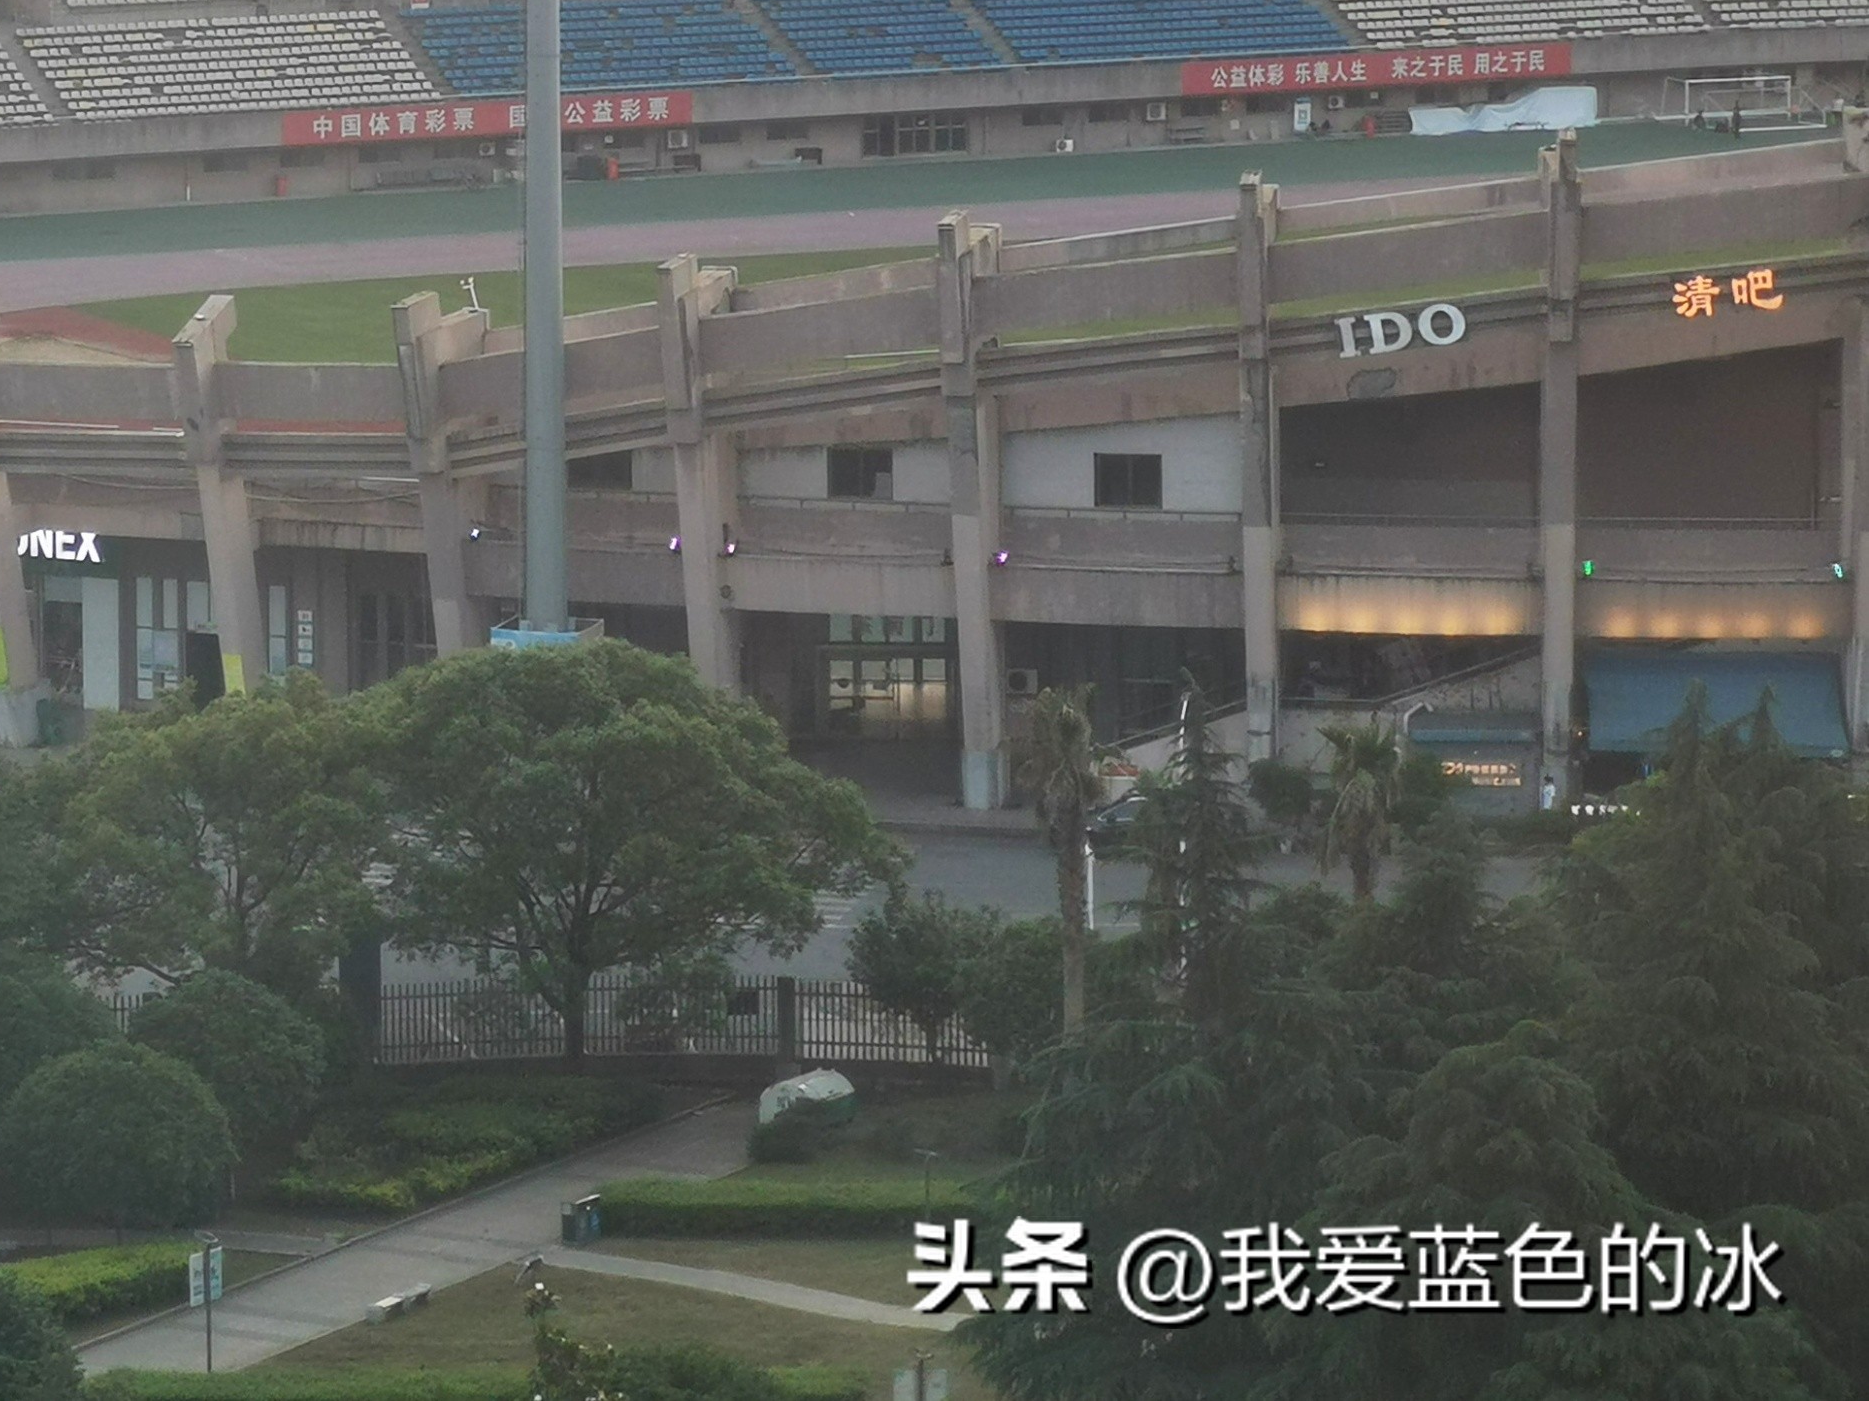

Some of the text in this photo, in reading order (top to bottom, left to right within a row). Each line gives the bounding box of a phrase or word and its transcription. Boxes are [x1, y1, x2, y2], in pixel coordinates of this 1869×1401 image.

[1211, 50, 1545, 88] 公益体彩 乐善人生 来之于民 用之于民
[313, 107, 474, 139] 中国体育彩票
[1673, 269, 1785, 319] 清吧
[1334, 303, 1466, 359] IDO
[17, 529, 101, 563] NEX
